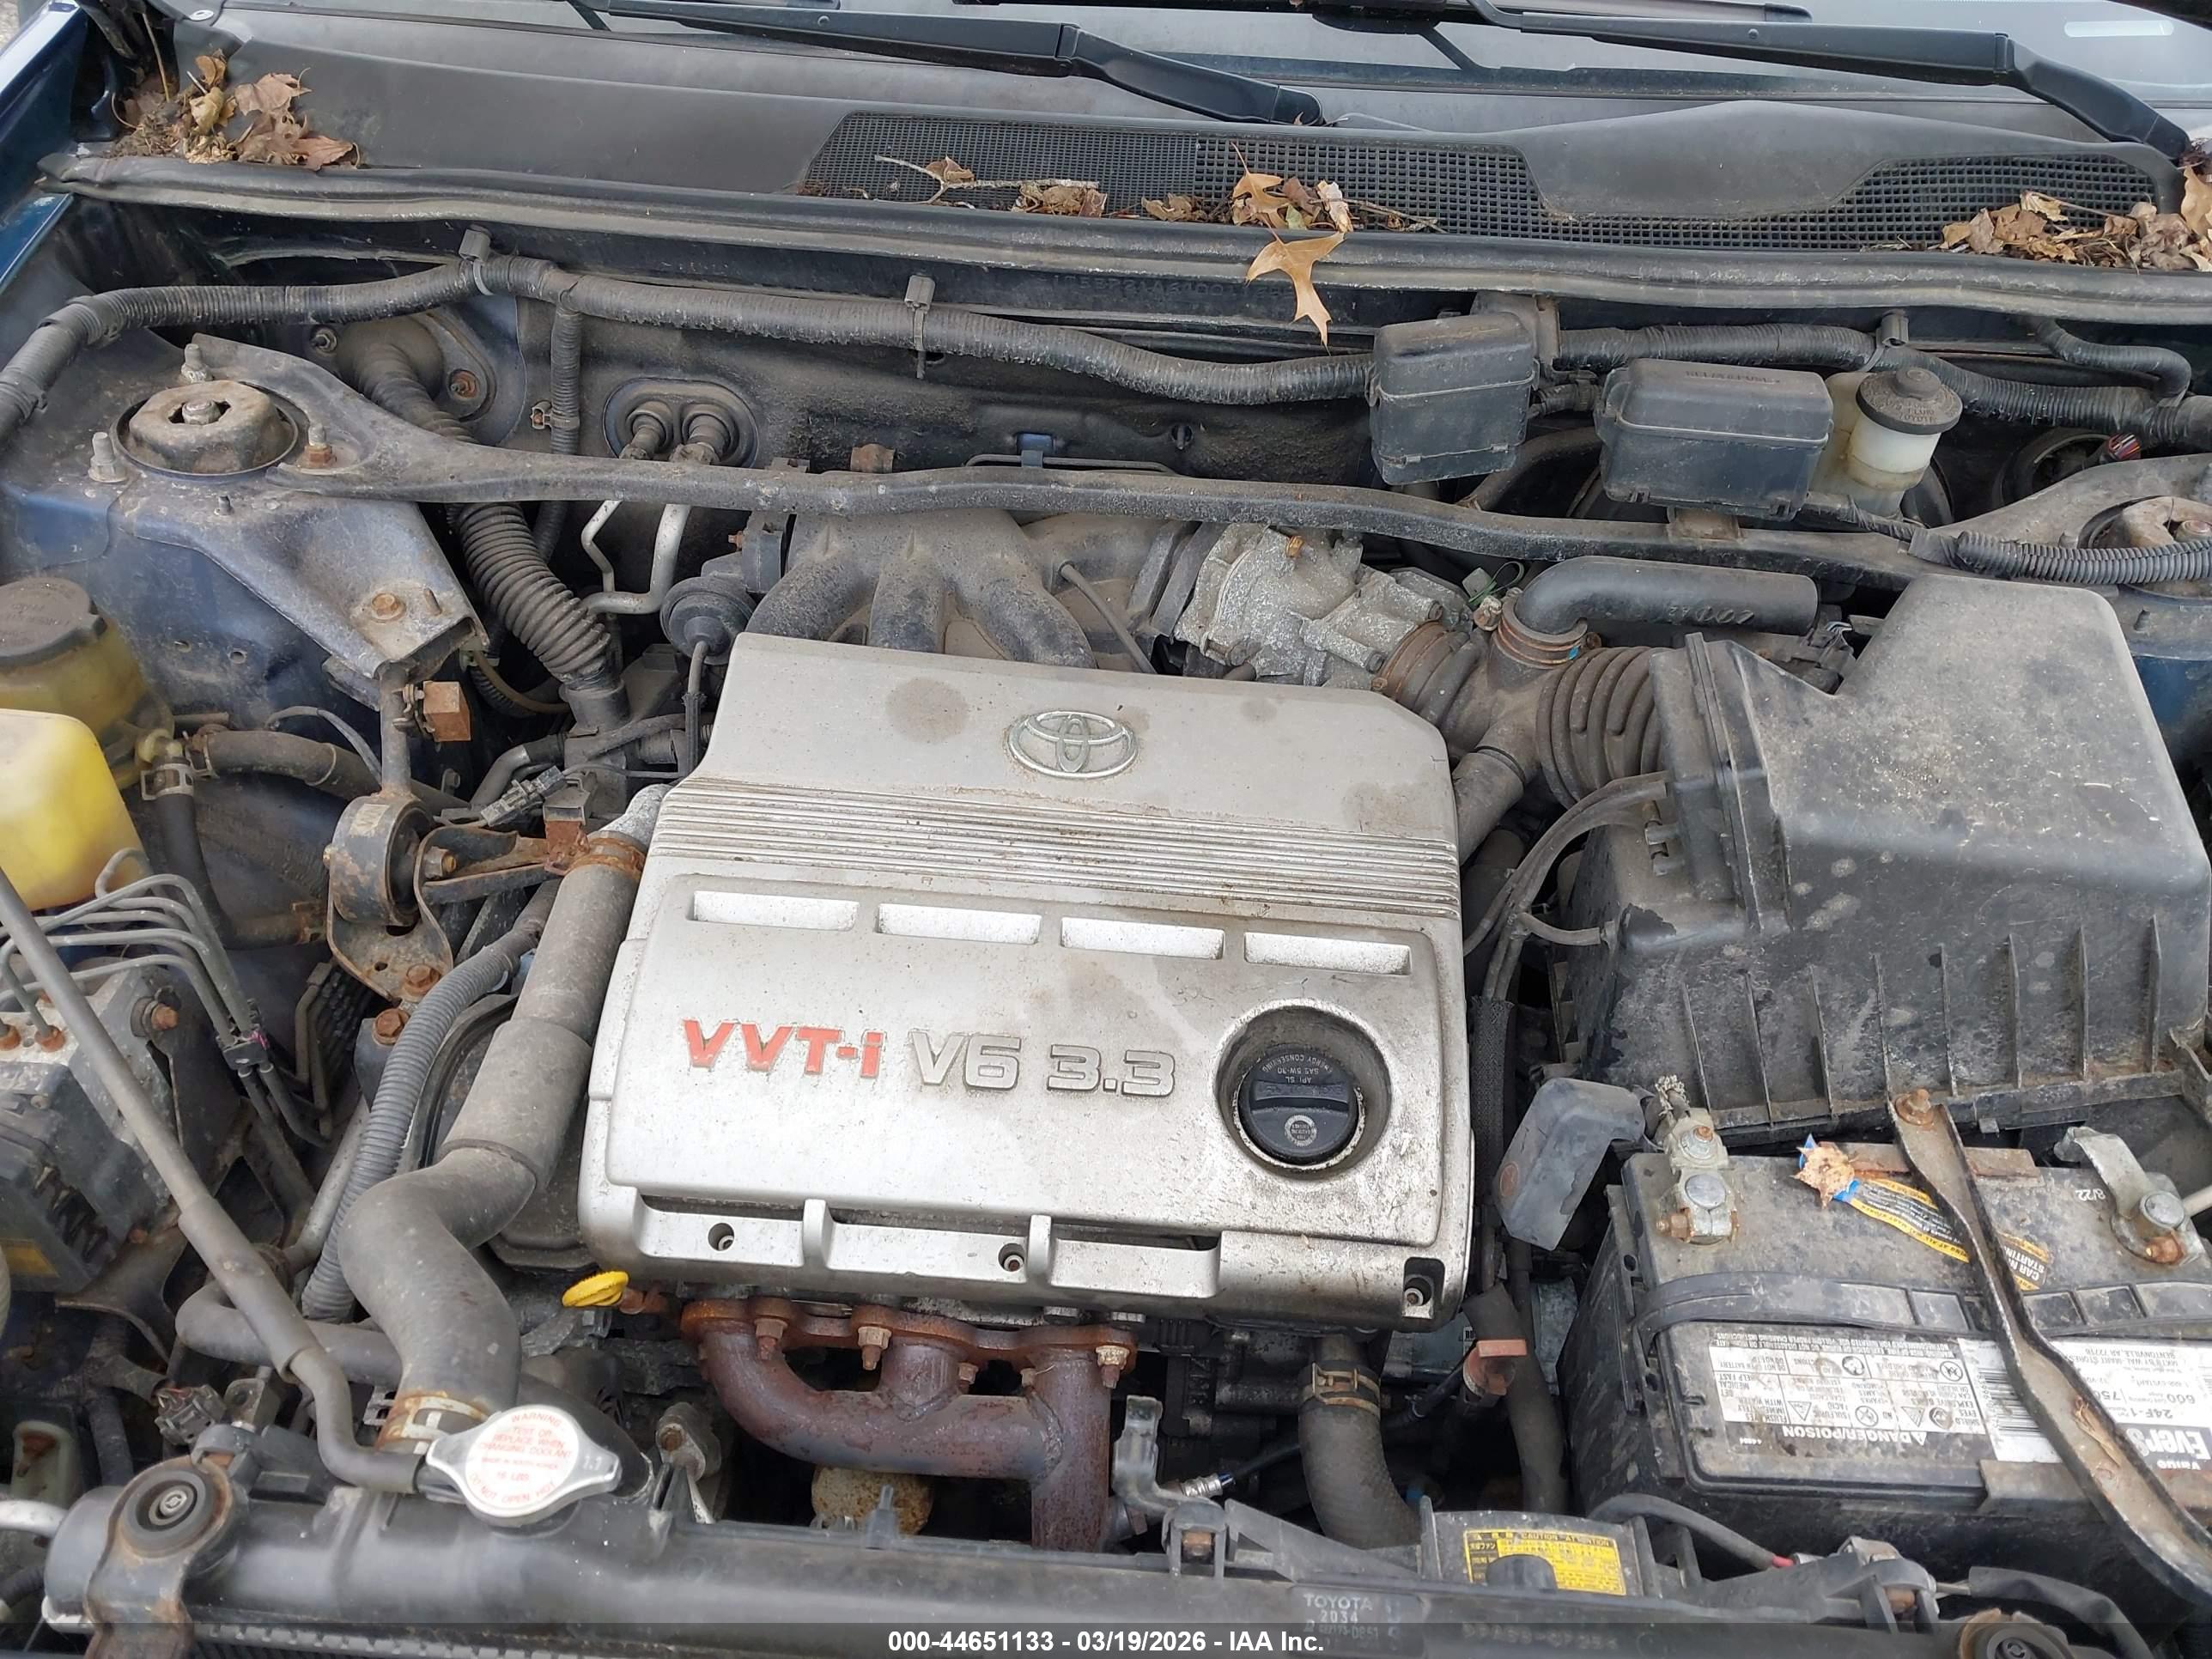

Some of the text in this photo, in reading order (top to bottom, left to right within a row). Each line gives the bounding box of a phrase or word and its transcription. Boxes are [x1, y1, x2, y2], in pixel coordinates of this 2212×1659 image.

[683, 1018, 1176, 1098] VVT-i V6 3.3
[1261, 1054, 1333, 1073] ENERGY CONSERVING
[2075, 1188, 2106, 1201] 8/22
[2004, 1246, 2045, 1273] STARTIN
[2020, 1264, 2039, 1280] CAR
[1718, 1381, 1750, 1389] MEDICAL
[2166, 1394, 2195, 1404] 600
[511, 1413, 562, 1427] WARNING
[2130, 1407, 2173, 1419] 24F-1
[1783, 1425, 1911, 1443] DANGER/POISON
[2126, 1428, 2212, 1460] EverS
[2156, 1459, 2201, 1470] Value
[501, 1493, 530, 1504] OPEN
[1565, 1536, 1609, 1546] ATTTION
[1303, 1593, 1372, 1611] TOYOTA
[1320, 1610, 1358, 1624] 2034
